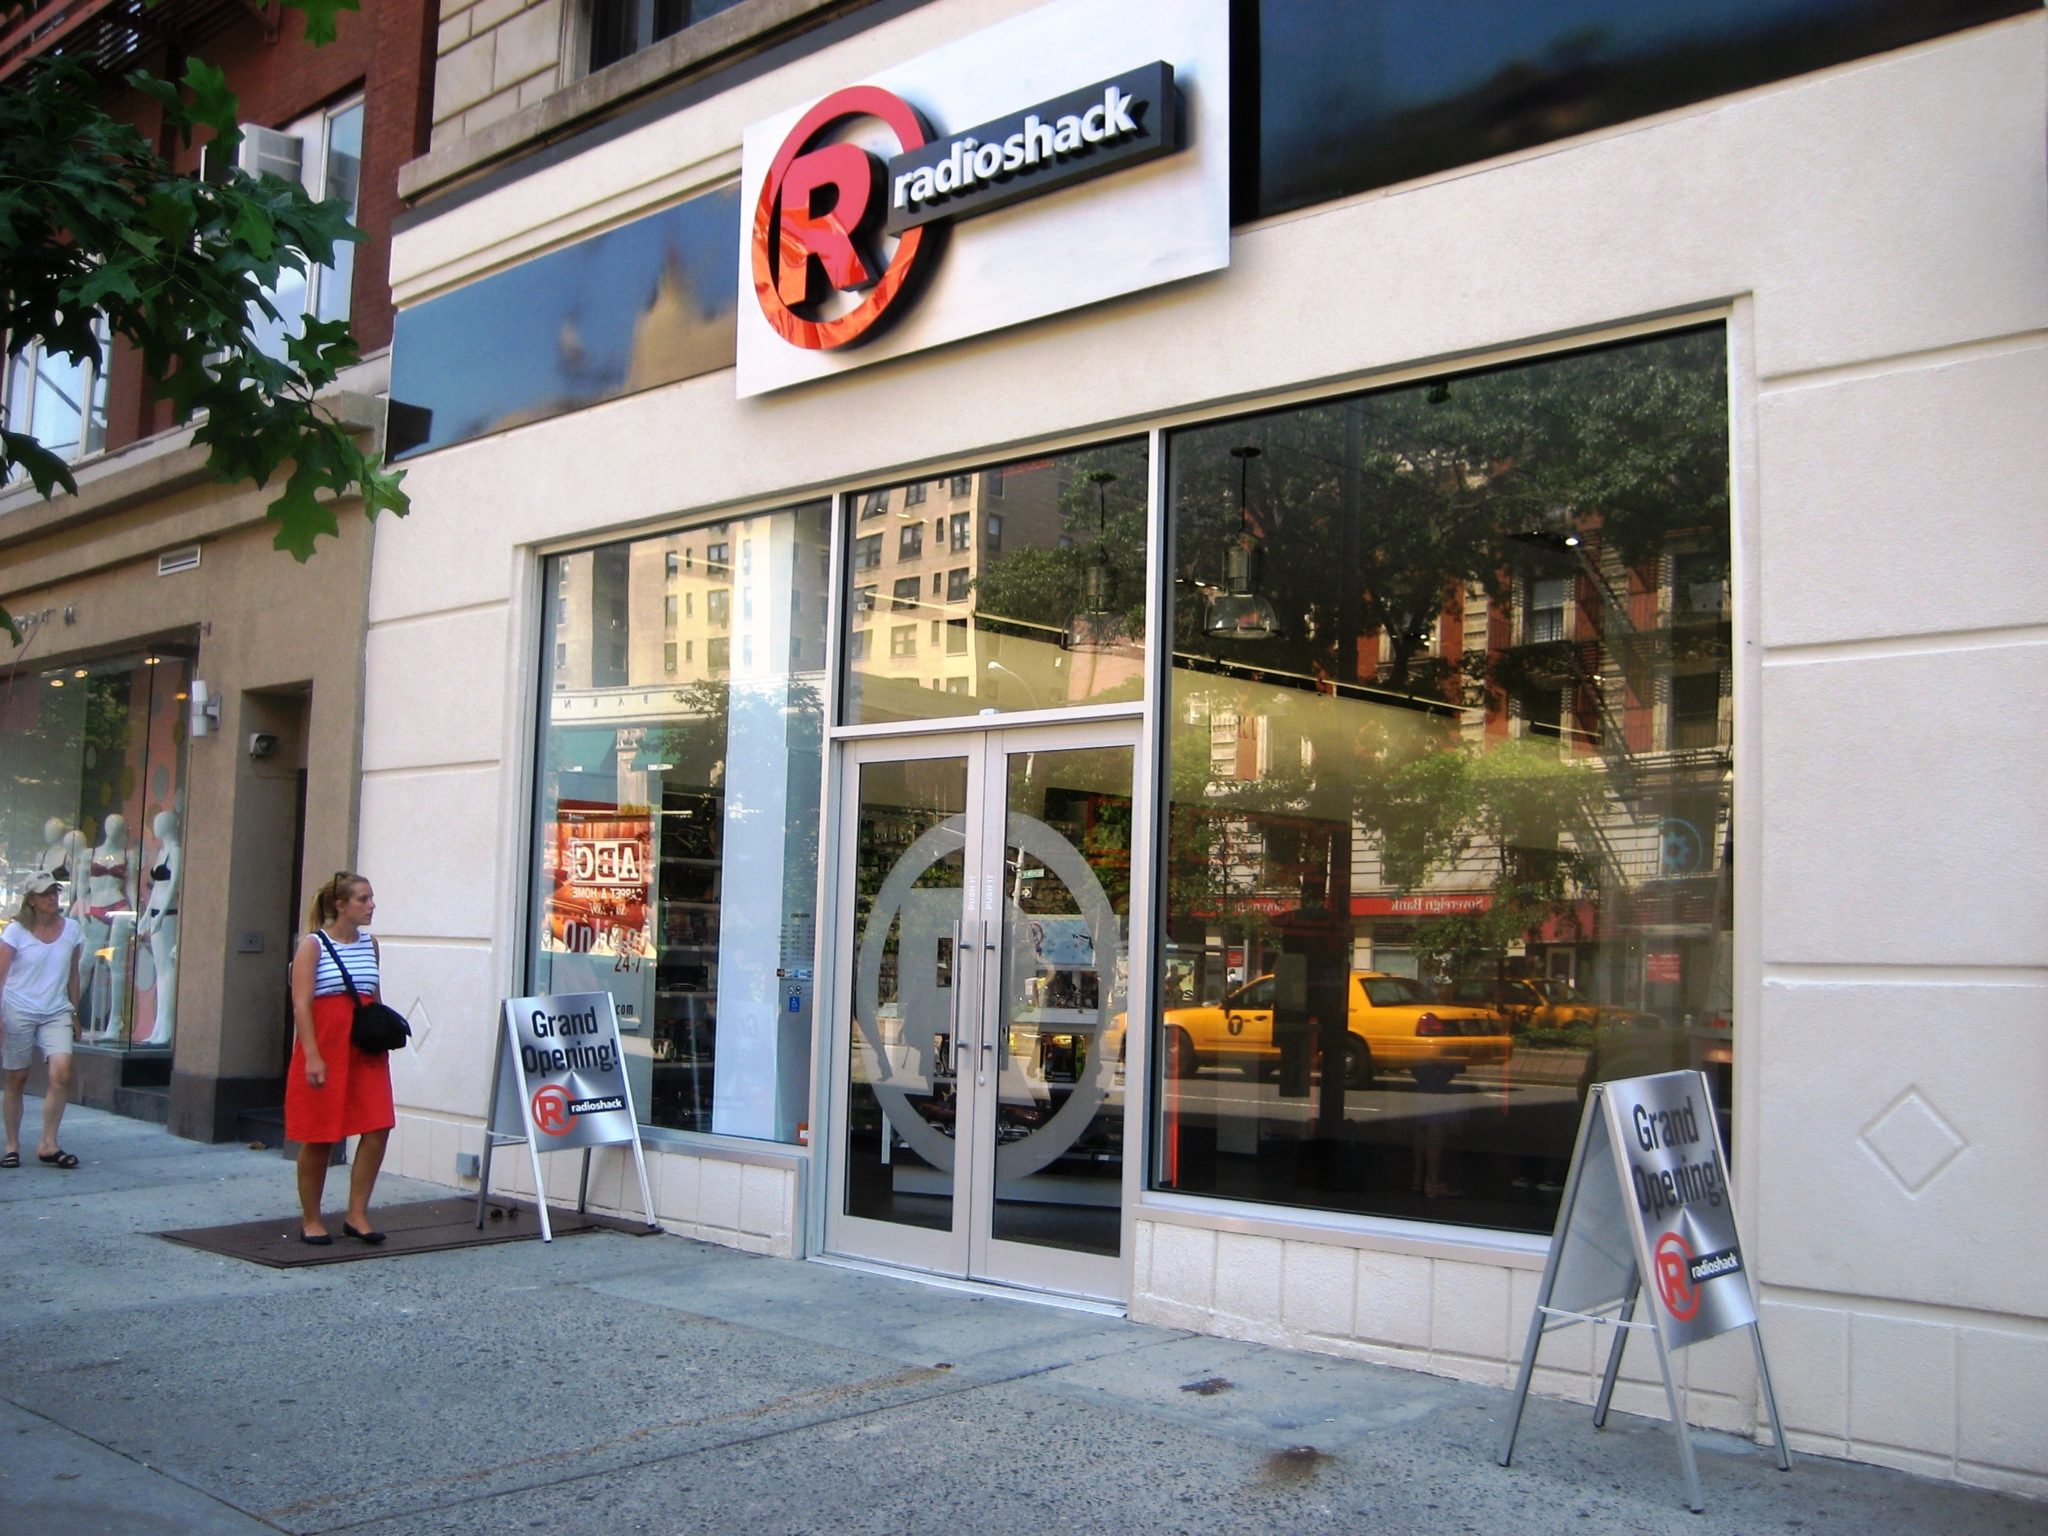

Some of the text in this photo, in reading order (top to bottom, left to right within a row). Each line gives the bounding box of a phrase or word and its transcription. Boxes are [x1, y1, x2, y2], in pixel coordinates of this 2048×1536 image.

[894, 86, 1138, 208] radioshack
[776, 143, 878, 306] R
[968, 886, 977, 911] PUSH
[986, 885, 994, 910] PUSH
[531, 1005, 599, 1039] Grand
[522, 1037, 619, 1075] Opening!
[570, 1097, 624, 1115] radioshack
[1632, 1096, 1700, 1153] Grand
[1631, 1150, 1726, 1221] Opening!
[1690, 1252, 1738, 1279] radioshack
